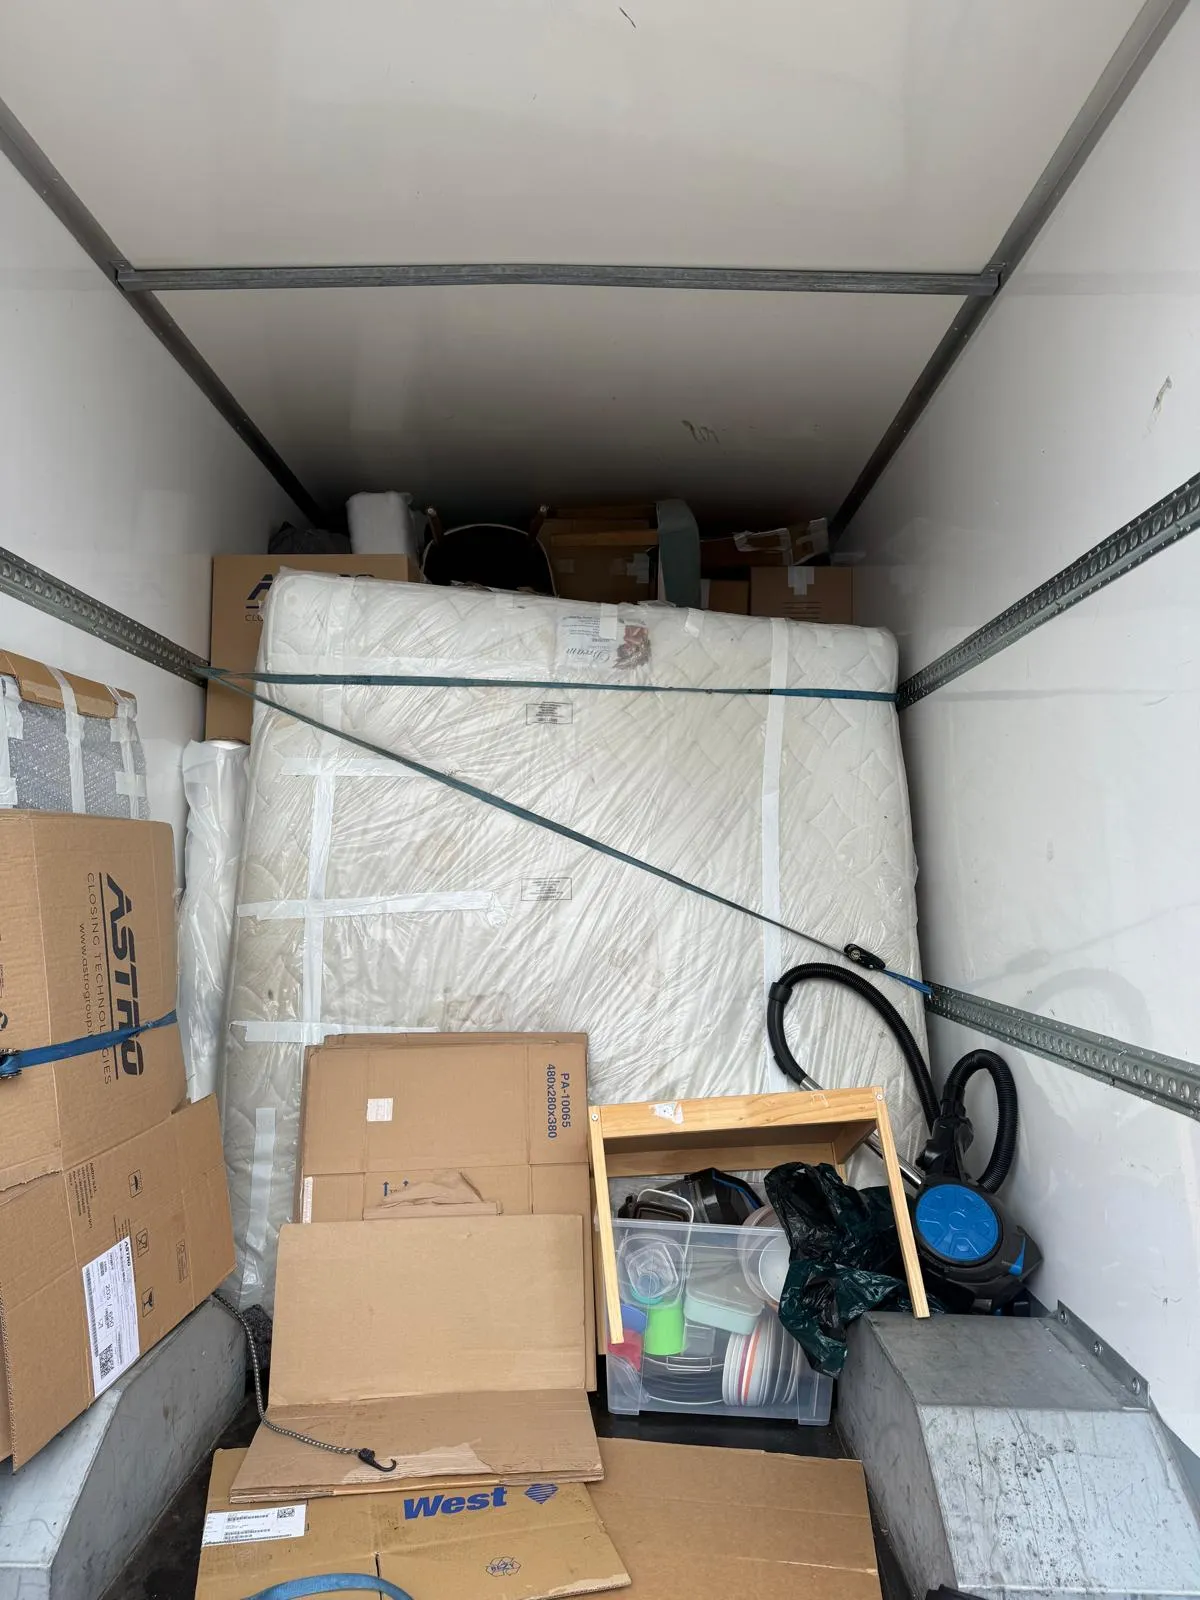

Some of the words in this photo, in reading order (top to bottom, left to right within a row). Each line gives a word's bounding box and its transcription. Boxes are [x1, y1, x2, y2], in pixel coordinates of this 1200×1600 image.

[87, 872, 100, 946] CLOSING
[79, 923, 93, 1037] www.astrogroup.i
[107, 873, 144, 1076] ASTRO
[94, 953, 112, 1085] TECHNOLGIES
[546, 1064, 557, 1138] 480x280x380
[560, 1072, 571, 1128] PA-10065
[403, 1486, 507, 1520] West
